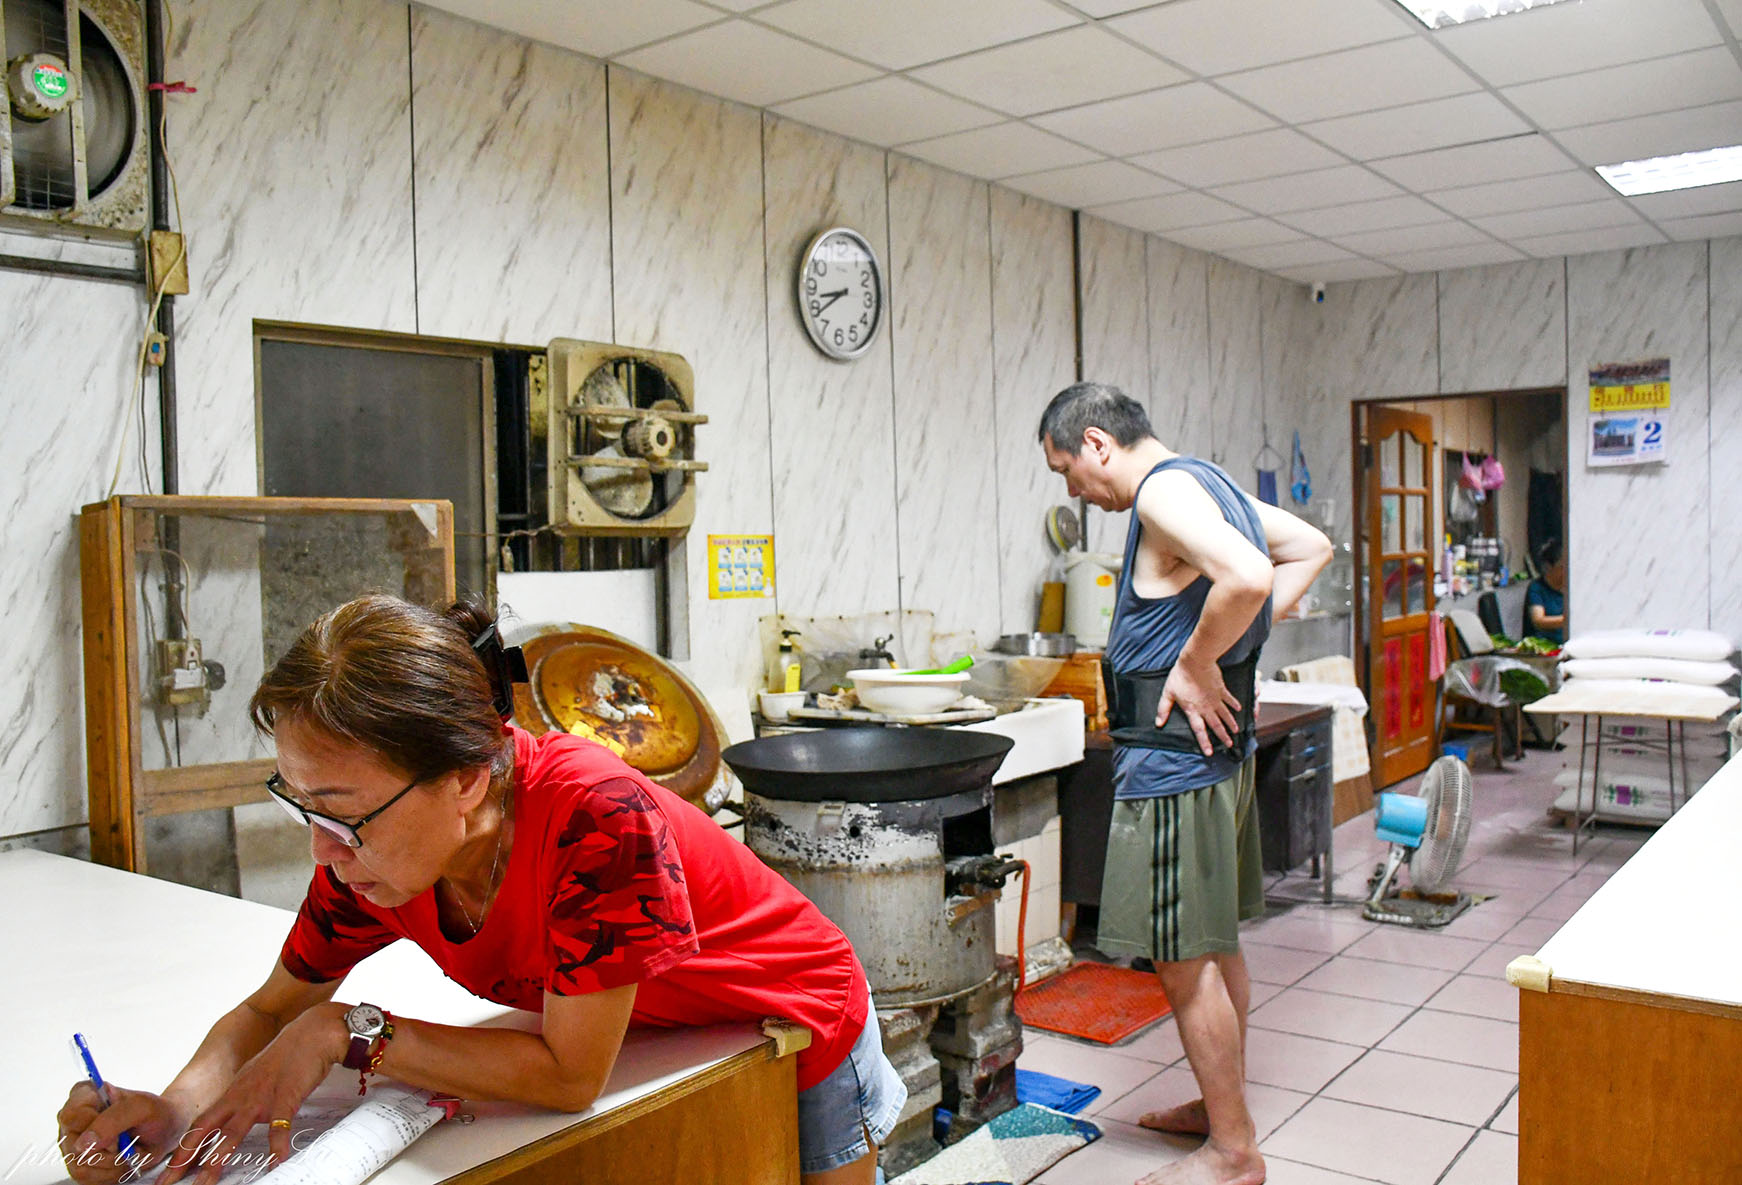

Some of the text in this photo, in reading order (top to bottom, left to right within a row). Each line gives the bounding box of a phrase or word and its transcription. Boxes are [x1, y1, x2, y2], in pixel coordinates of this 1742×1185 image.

[812, 259, 827, 277] 10
[806, 277, 818, 296] 9
[860, 270, 870, 288] 2
[810, 299, 820, 318] 8
[863, 291, 873, 309] 3
[820, 318, 830, 337] 7
[859, 312, 868, 325] 4
[833, 328, 844, 346] 6
[848, 325, 858, 342] 5
[1643, 421, 1662, 444] 2
